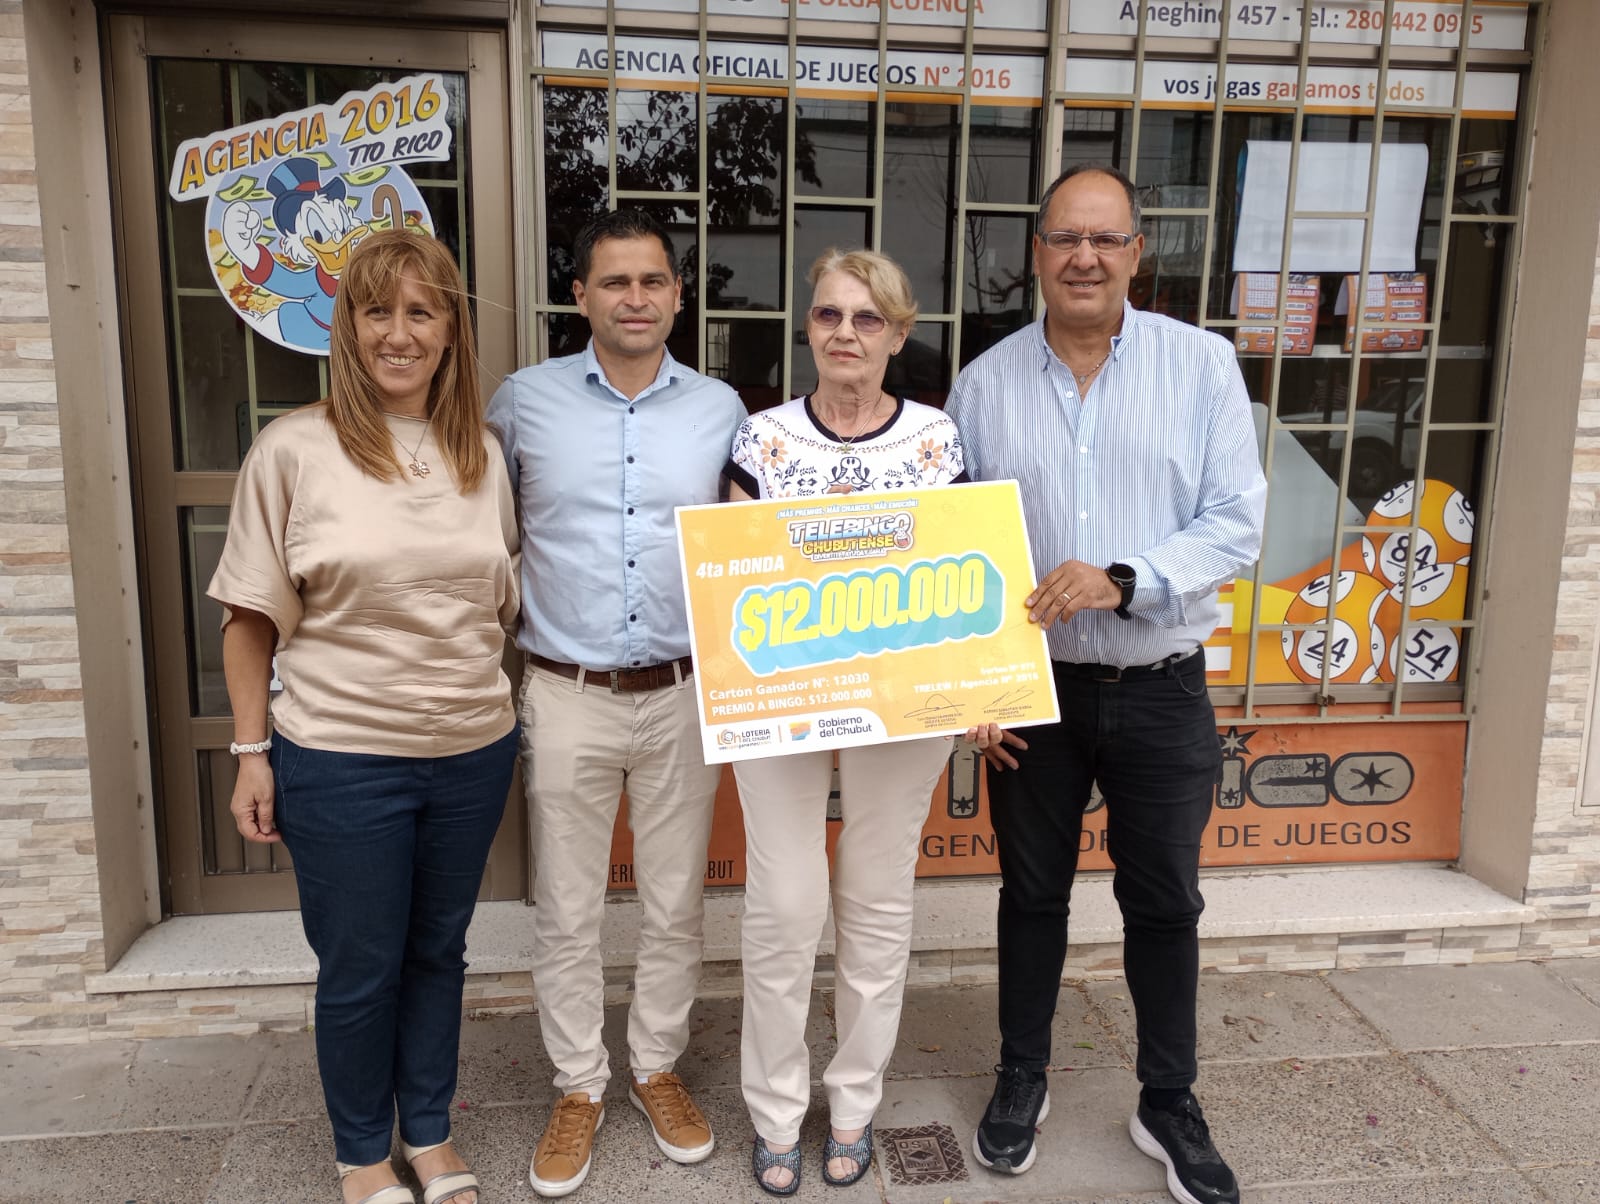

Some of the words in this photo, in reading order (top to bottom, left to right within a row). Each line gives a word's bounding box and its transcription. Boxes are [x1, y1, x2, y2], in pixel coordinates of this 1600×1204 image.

[1237, 5, 1277, 26] 457
[1346, 9, 1384, 30] 280
[1391, 11, 1427, 32] 442
[1433, 13, 1483, 34] 095
[575, 48, 685, 74] AGENCIA
[692, 55, 784, 78] OFICIAL
[795, 60, 821, 81] DE
[827, 62, 916, 85] JUEGOS
[924, 65, 950, 87] N°
[957, 67, 1011, 89] 2016
[1164, 78, 1199, 95] vos
[1367, 81, 1425, 102] tdos
[178, 111, 329, 194] AGENCIA
[339, 79, 442, 144] 2016
[349, 141, 386, 167] TIO
[392, 130, 443, 158] RICO
[789, 513, 911, 545] TELEBINGO
[802, 534, 895, 555] CHUBUTENSE
[1391, 535, 1433, 571] 84
[696, 560, 723, 579] 4ta
[728, 555, 785, 577] RONDA
[739, 558, 986, 652] $12.000.000
[1405, 629, 1452, 673] 54
[709, 686, 752, 701] Cartón
[756, 679, 809, 696] Ganador
[833, 672, 869, 687] 12030
[960, 677, 999, 690] Agencia
[711, 702, 755, 717] PREMIO
[757, 701, 766, 712] A
[768, 696, 806, 711] BINGO:
[808, 687, 872, 706] $12.000.000
[741, 728, 771, 738] LOTERIA
[818, 716, 863, 728] Gobierno
[819, 728, 835, 738] del
[836, 723, 873, 736] Chubut
[1217, 824, 1261, 848] DE
[1273, 821, 1412, 848] JUEGOS
